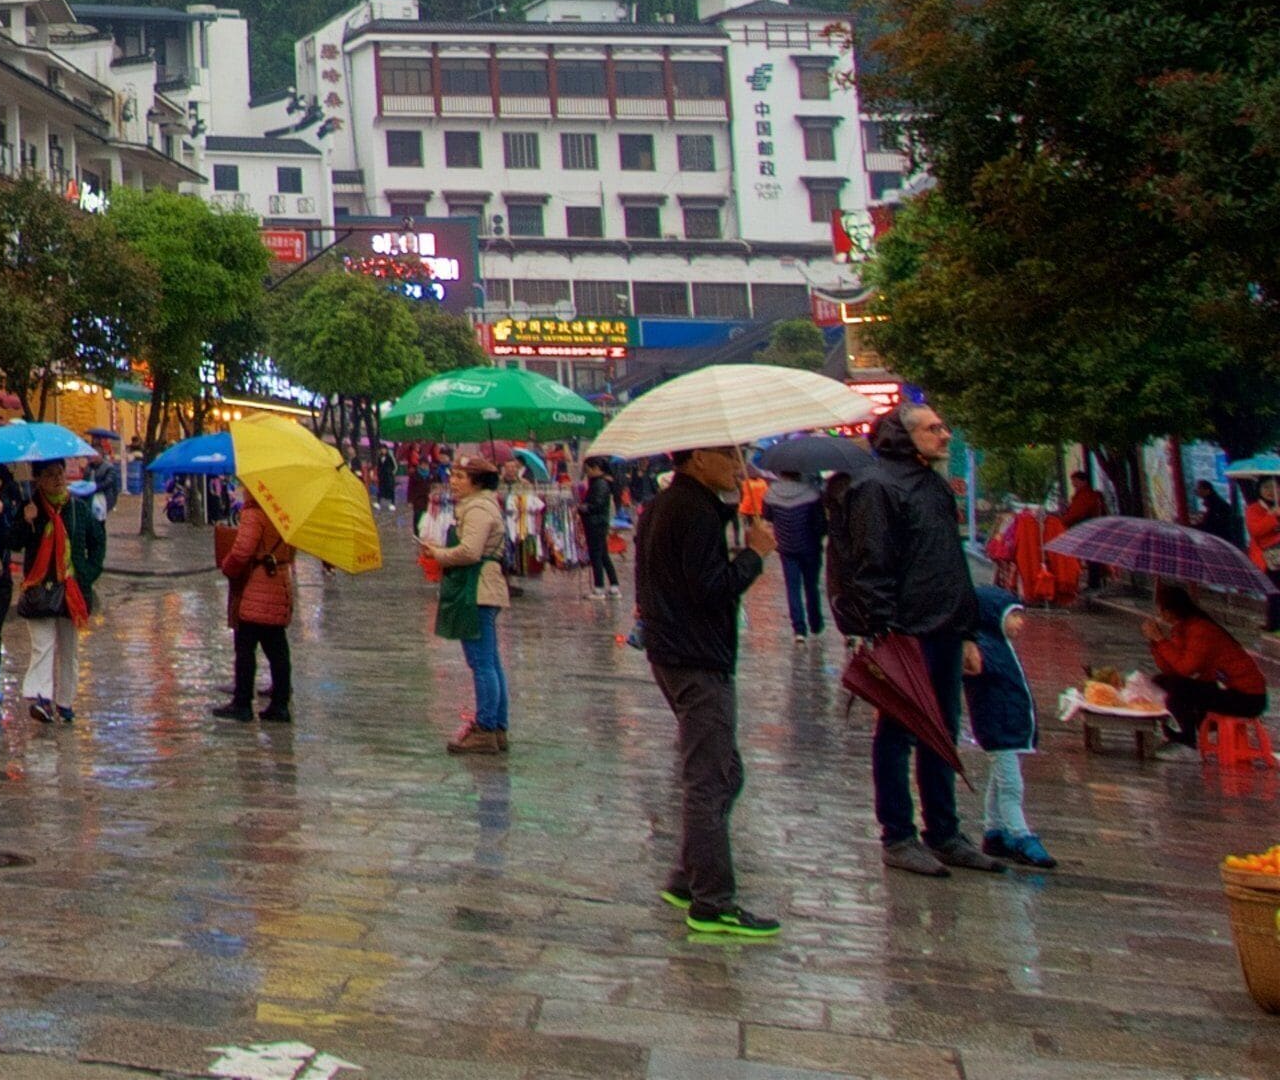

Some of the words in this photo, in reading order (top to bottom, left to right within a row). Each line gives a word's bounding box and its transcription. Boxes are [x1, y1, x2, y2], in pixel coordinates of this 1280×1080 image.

[754, 100, 776, 177] 中国邮政
[754, 183, 782, 191] CHINA
[758, 191, 779, 200] POST
[515, 320, 627, 335] 中国邮政储蓄银行
